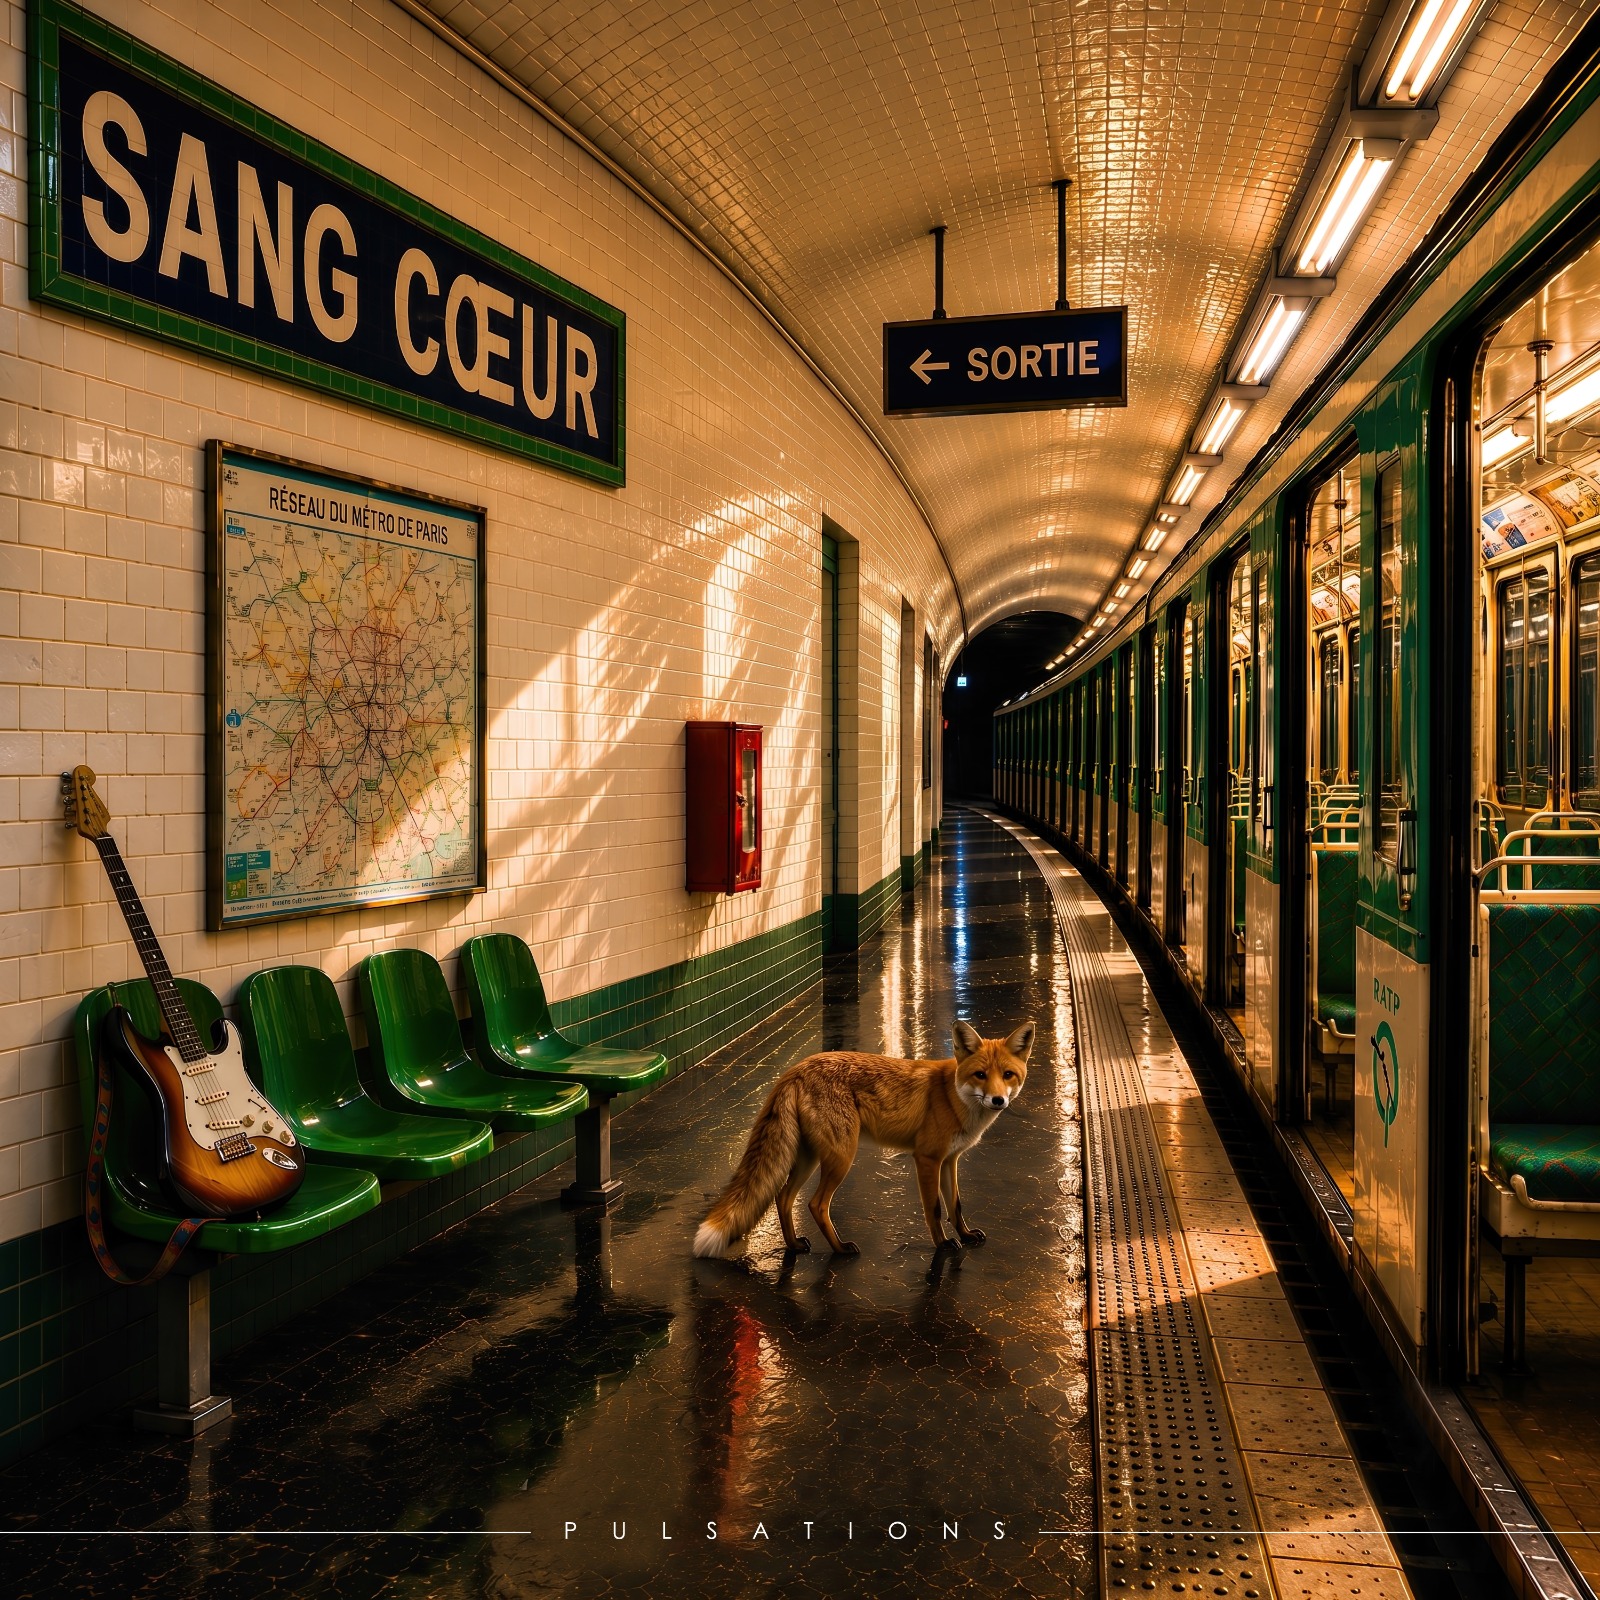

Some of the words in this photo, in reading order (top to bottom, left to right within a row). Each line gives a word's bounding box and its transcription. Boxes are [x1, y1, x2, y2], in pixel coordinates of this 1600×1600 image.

[81, 90, 359, 343] SANG
[395, 248, 599, 439] CŒUR
[967, 340, 1100, 382] SORTIE
[269, 485, 325, 520] RÉSEAU
[329, 501, 348, 524] DU
[352, 504, 395, 534] MÉTRO
[398, 516, 413, 538] DE
[416, 520, 448, 545] PARIS
[1374, 977, 1401, 1016] RATP
